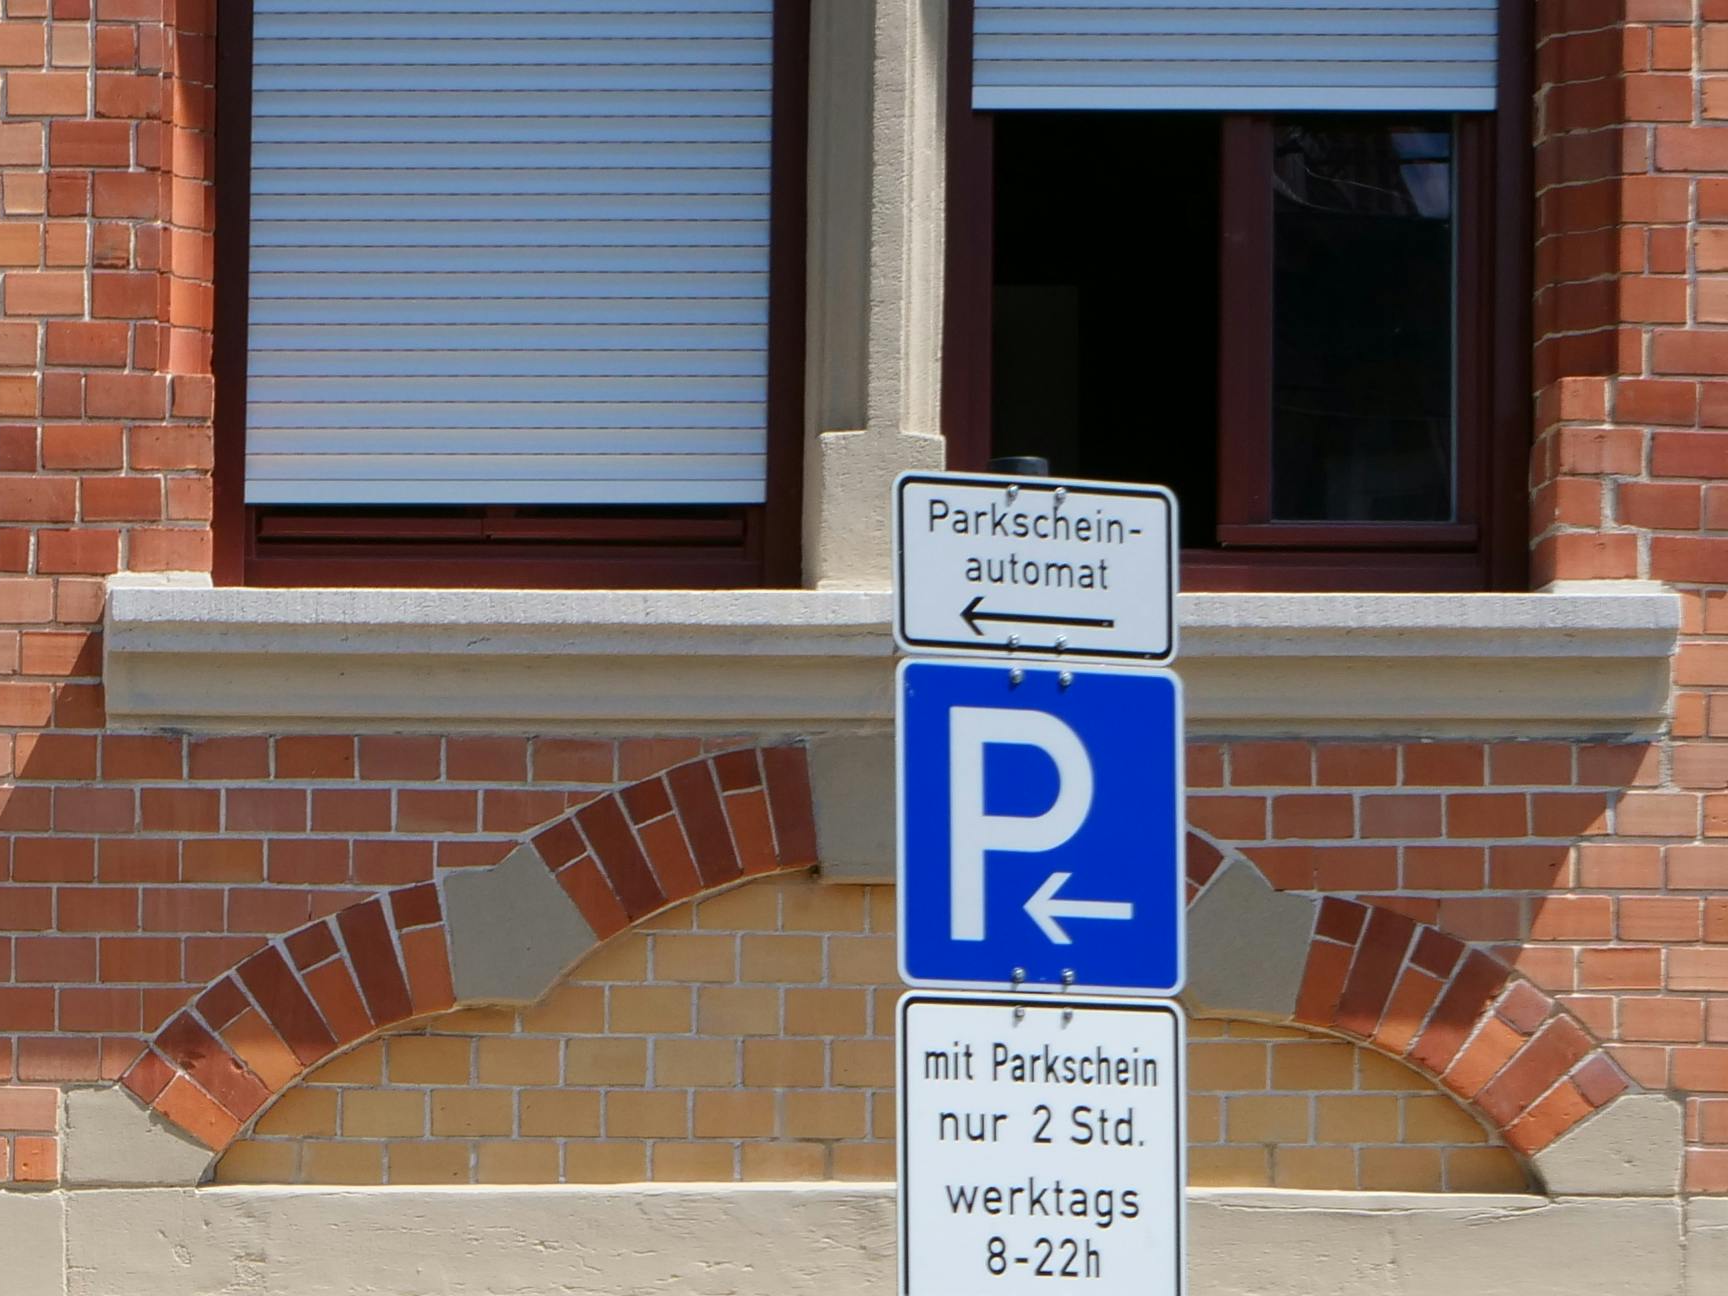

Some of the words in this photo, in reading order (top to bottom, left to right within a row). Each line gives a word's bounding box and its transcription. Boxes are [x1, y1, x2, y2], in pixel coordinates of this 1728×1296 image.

[928, 499, 1143, 545] Parkschein-
[964, 553, 1109, 591] automat
[949, 705, 1094, 942] P
[924, 1043, 974, 1081] mit
[992, 1042, 1158, 1087] Parkschein
[939, 1110, 1008, 1143] nur
[1032, 1104, 1053, 1145] 2
[1070, 1105, 1146, 1148] Std.
[946, 1176, 1140, 1229] werktags
[986, 1236, 1101, 1279] 8-22h
